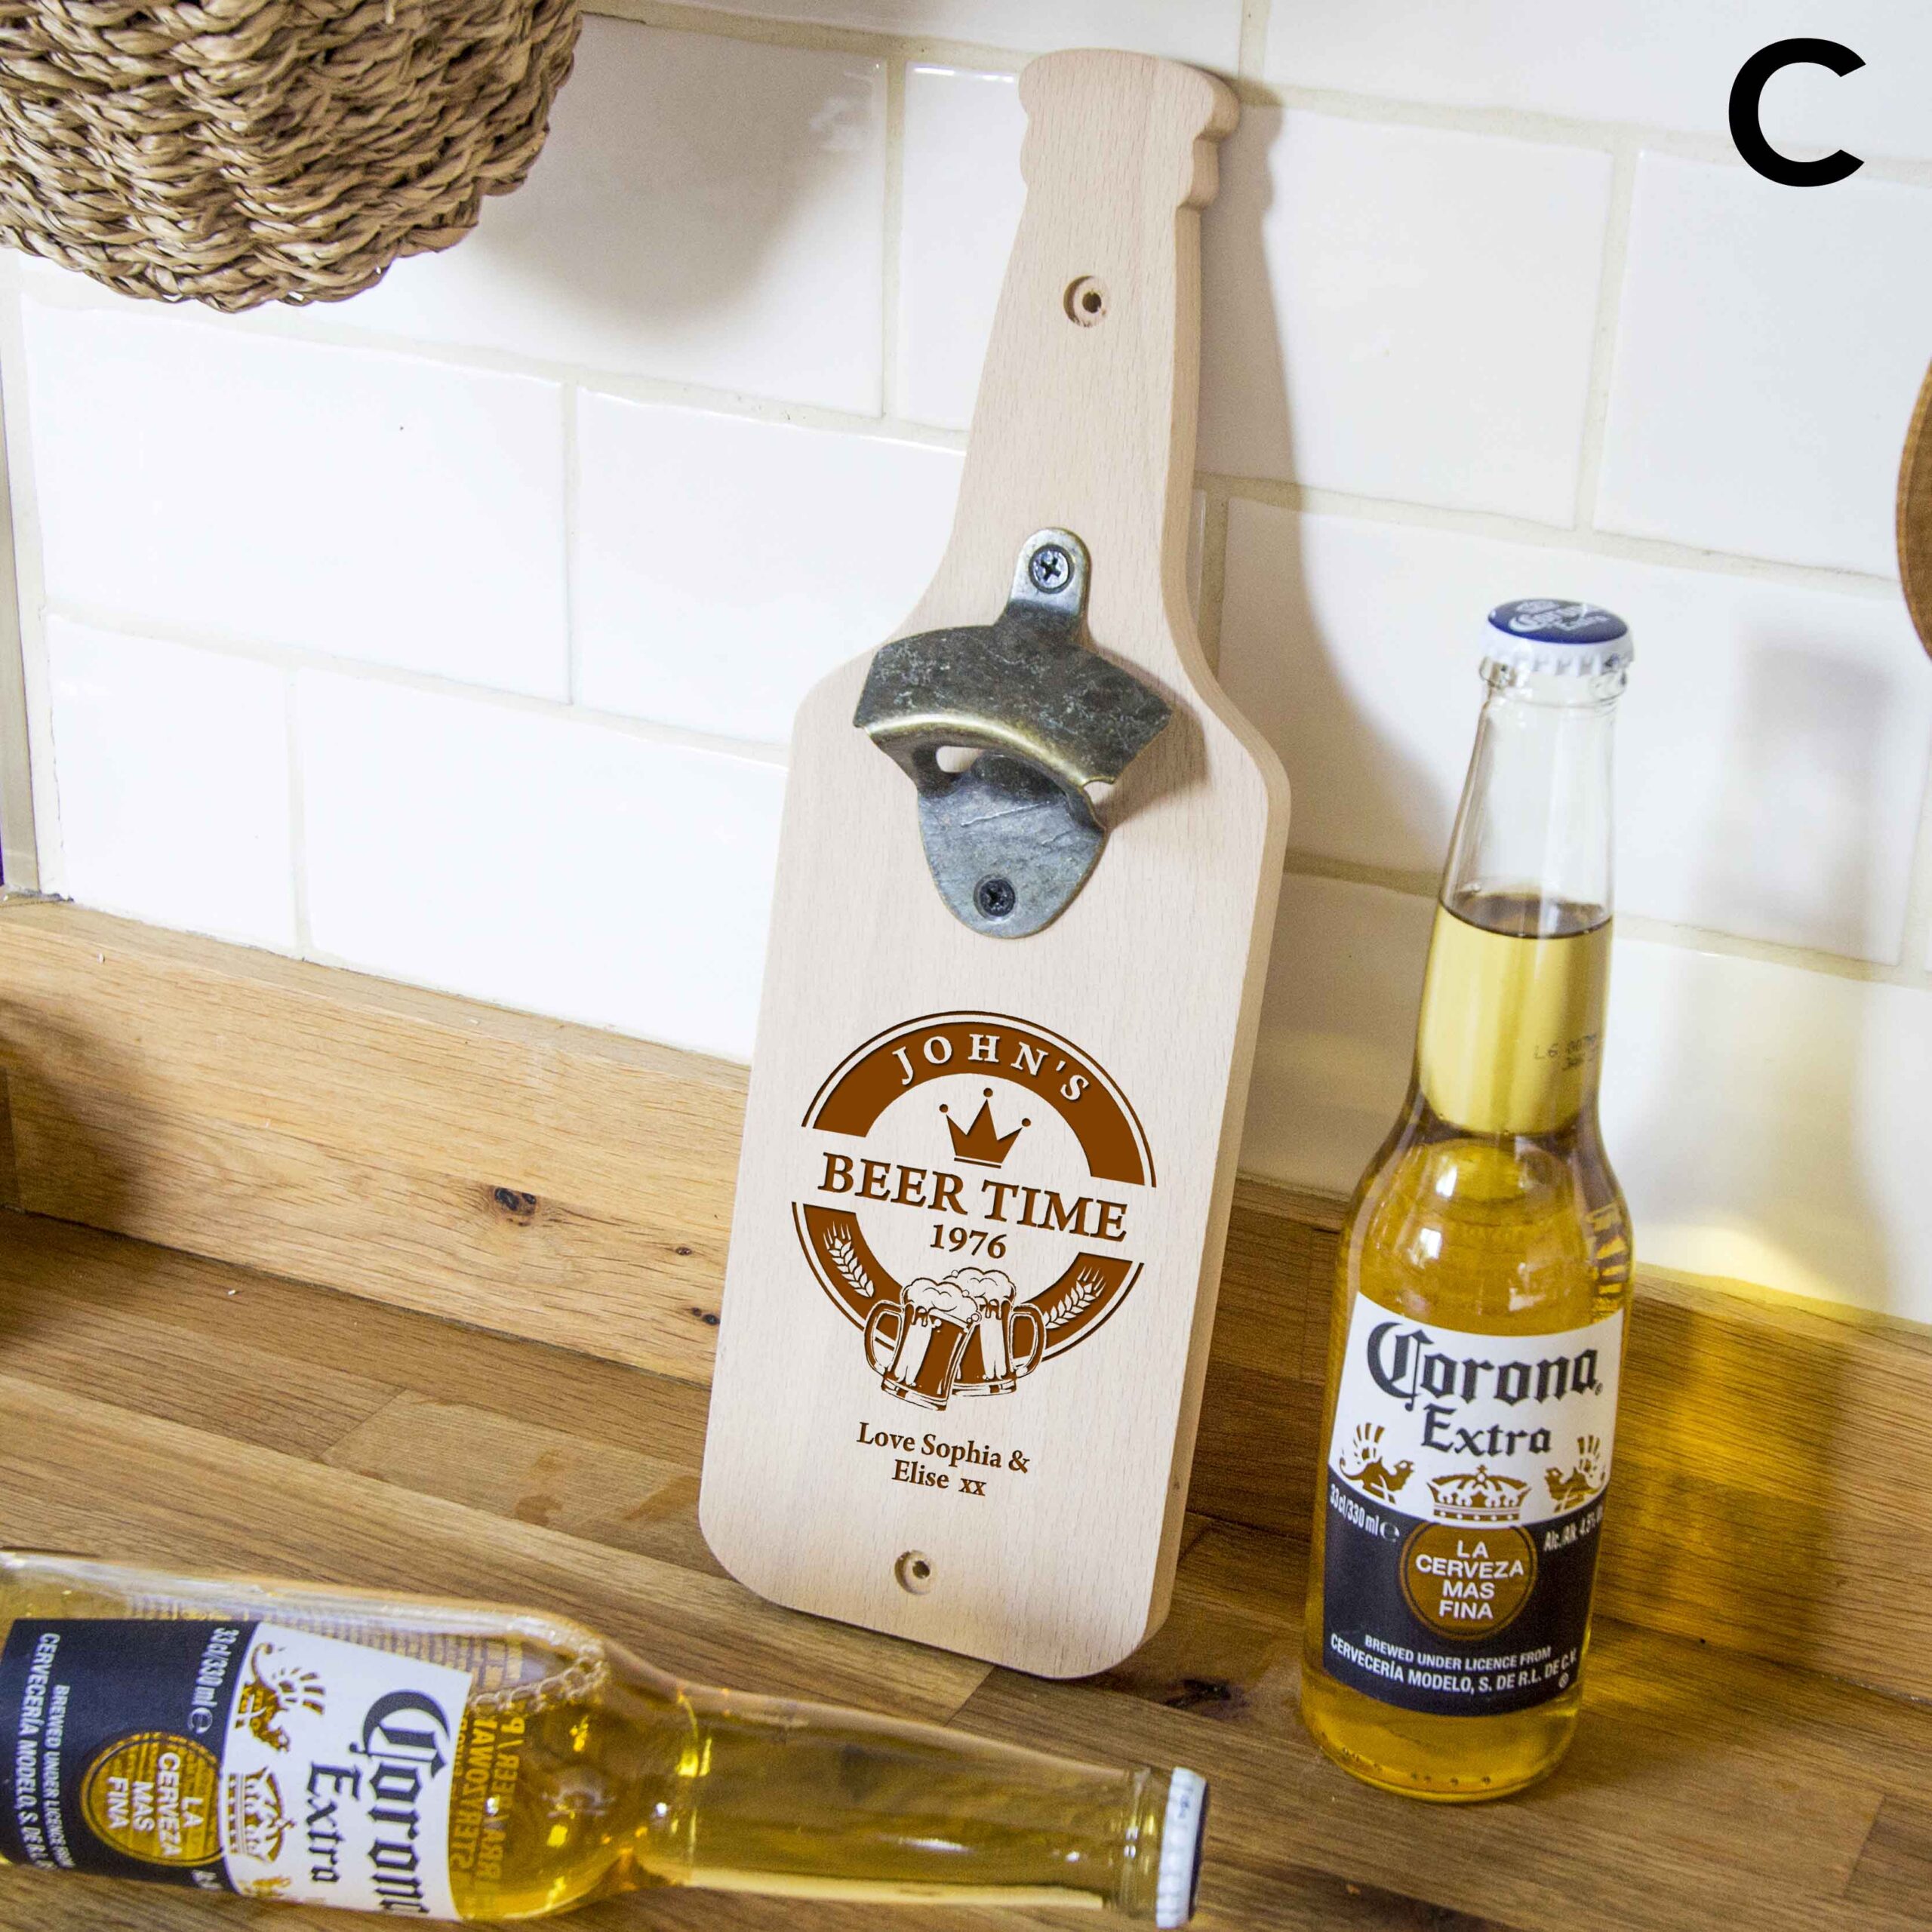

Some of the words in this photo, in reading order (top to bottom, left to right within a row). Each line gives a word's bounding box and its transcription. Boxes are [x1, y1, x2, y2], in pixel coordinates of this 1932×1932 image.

[893, 1033, 1089, 1101] JOHN'S
[817, 1152, 968, 1215] BEER
[981, 1179, 1128, 1242] TIME
[930, 1223, 1008, 1259] 1976
[857, 1422, 915, 1451] Love
[921, 1433, 1001, 1468] Sophia
[1008, 1450, 1030, 1473] &
[1421, 1403, 1551, 1457] Extra
[891, 1459, 949, 1489] Elise
[958, 1478, 986, 1496] xx
[1416, 1554, 1524, 1579] CERVEZA
[1457, 1540, 1489, 1558] LA
[1439, 1599, 1494, 1620] FINA
[1443, 1580, 1495, 1599] MAS
[1331, 1633, 1404, 1683] CERVECERÍA
[1407, 1669, 1475, 1695] MODELO,
[1478, 1677, 1492, 1692] S.
[1497, 1674, 1515, 1690] DE
[1518, 1668, 1542, 1686] R.L.
[1544, 1662, 1559, 1679] DE
[1364, 1635, 1414, 1662] BREWED
[1417, 1653, 1461, 1671] UNDER
[1465, 1655, 1517, 1672] LICENCE
[1519, 1646, 1552, 1665] FROM
[18, 1632, 61, 1736] CERVECERÍA
[44, 1684, 71, 1749] BREWED
[14, 1740, 38, 1809] MODELO,
[42, 1751, 60, 1798] UNDER
[42, 1800, 66, 1846] LICENCE
[107, 1776, 130, 1829] FINA
[131, 1780, 155, 1832] MAS
[157, 1752, 183, 1857] CERVEZA
[180, 1796, 204, 1828] LA
[306, 1761, 364, 1883] Extra
[20, 1826, 44, 1844] DE
